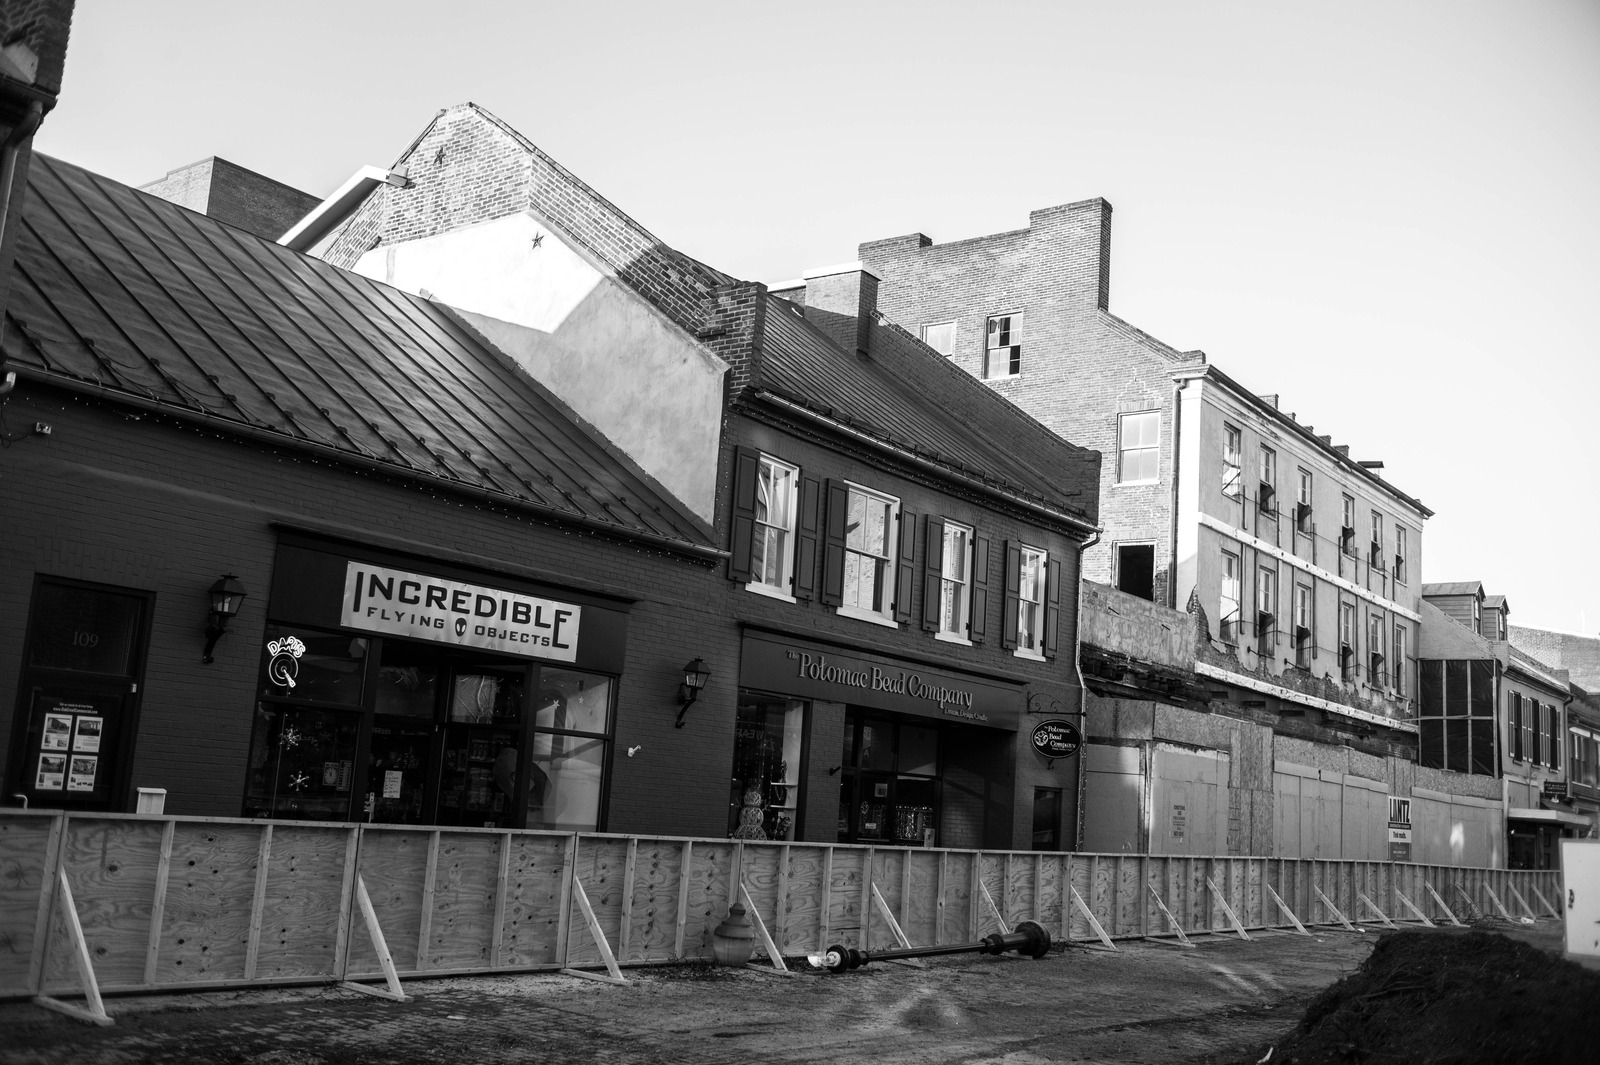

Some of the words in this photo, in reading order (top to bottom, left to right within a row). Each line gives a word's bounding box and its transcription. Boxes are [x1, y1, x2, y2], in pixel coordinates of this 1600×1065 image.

[353, 571, 572, 649] INCREDIBLE
[367, 606, 444, 629] FLYING
[474, 625, 550, 647] OBJECTS
[72, 631, 99, 648] 109
[267, 636, 306, 659] DARTS
[797, 652, 868, 688] Potomac
[870, 667, 906, 695] Bead
[907, 674, 973, 710] Company
[1047, 725, 1071, 734] Potomac
[1050, 740, 1076, 749] Company
[1389, 798, 1410, 823] LANTZ
